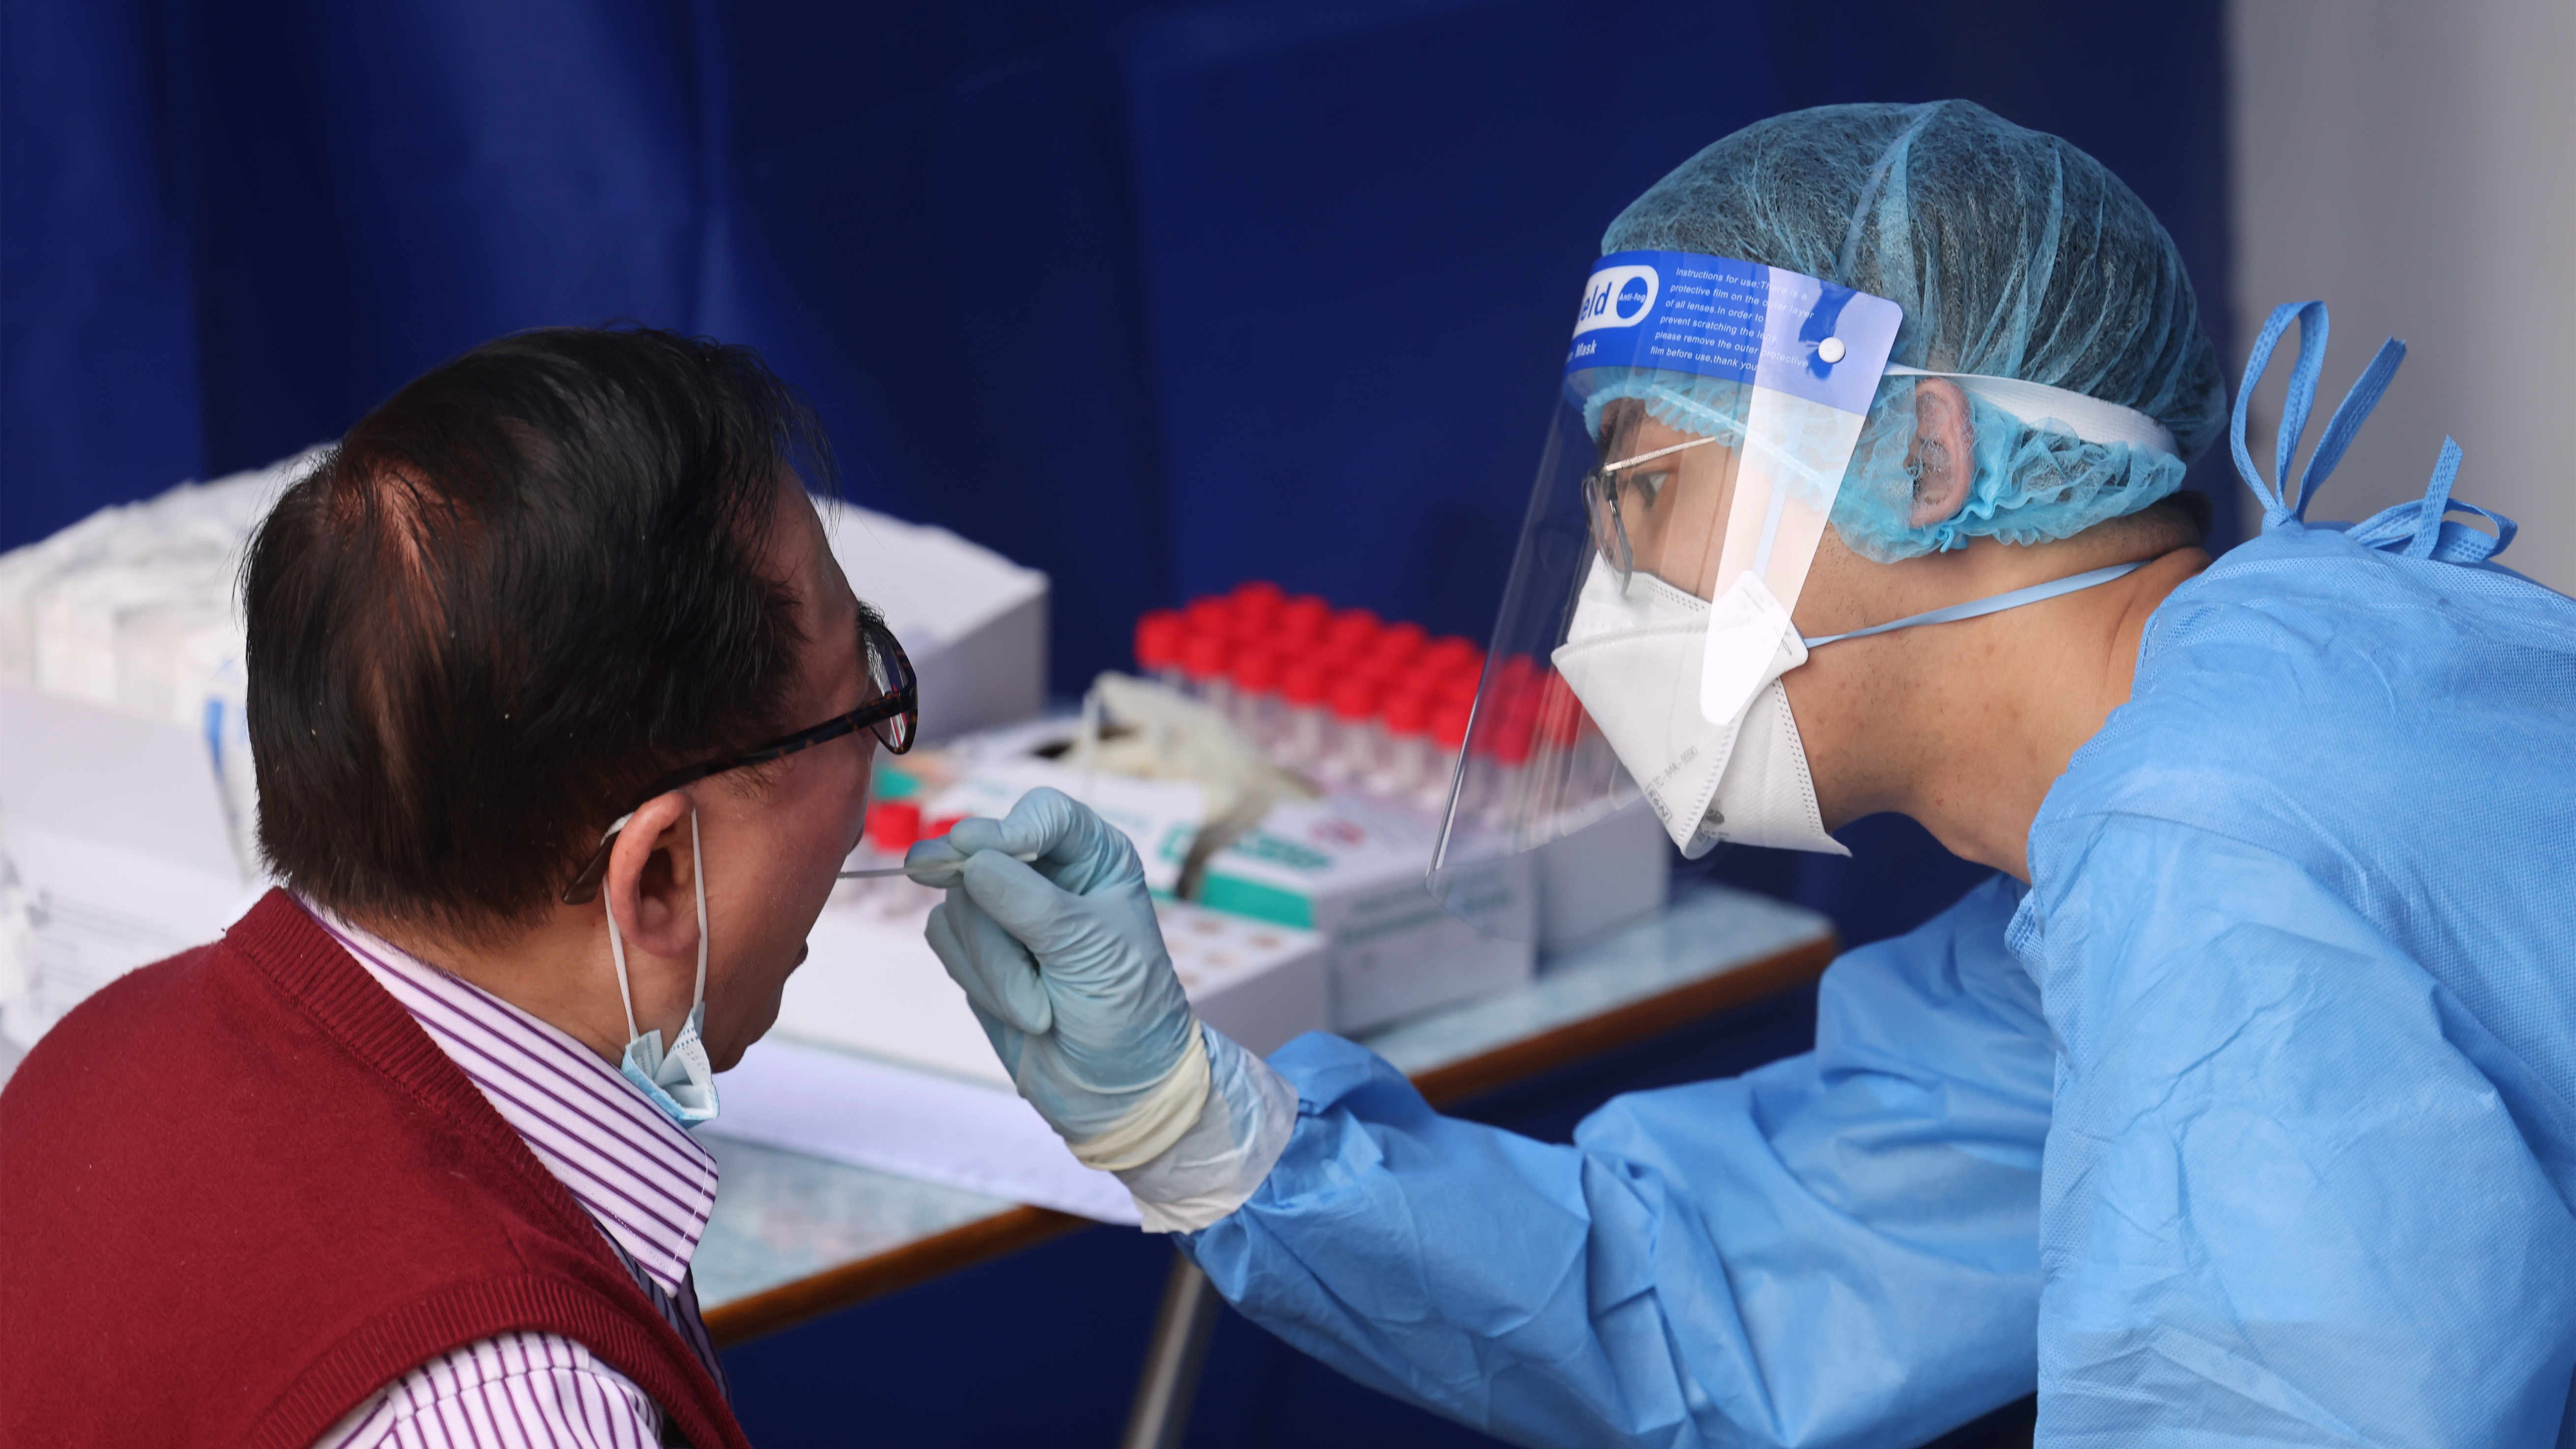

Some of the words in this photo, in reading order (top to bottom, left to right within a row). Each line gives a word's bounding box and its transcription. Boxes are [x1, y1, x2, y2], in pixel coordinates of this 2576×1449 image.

[1676, 267, 1723, 282] Instructions
[1726, 274, 1739, 283] for
[1790, 289, 1798, 298] is
[1618, 292, 1646, 303] Anti-fog
[1670, 284, 1710, 296] protective
[1713, 288, 1729, 299] film
[1731, 293, 1743, 302] on
[1746, 295, 1759, 305] the
[1762, 300, 1787, 311] outer
[1790, 306, 1814, 319] layer
[1666, 299, 1675, 307] of
[1675, 300, 1686, 309] all
[1728, 308, 1753, 320] order
[1755, 314, 1764, 323] to
[1660, 316, 1691, 326] prevent
[1693, 320, 1737, 335] scratching
[1740, 327, 1755, 337] the
[1575, 339, 1597, 358] Mask
[1650, 346, 1665, 355] film
[1666, 347, 1693, 360] before
[1740, 361, 1758, 372] you
[1655, 331, 1682, 341] please
[1684, 335, 1715, 346] remove
[1718, 339, 1732, 350] the
[1734, 344, 1758, 354] outer
[1760, 350, 1809, 368] protective
